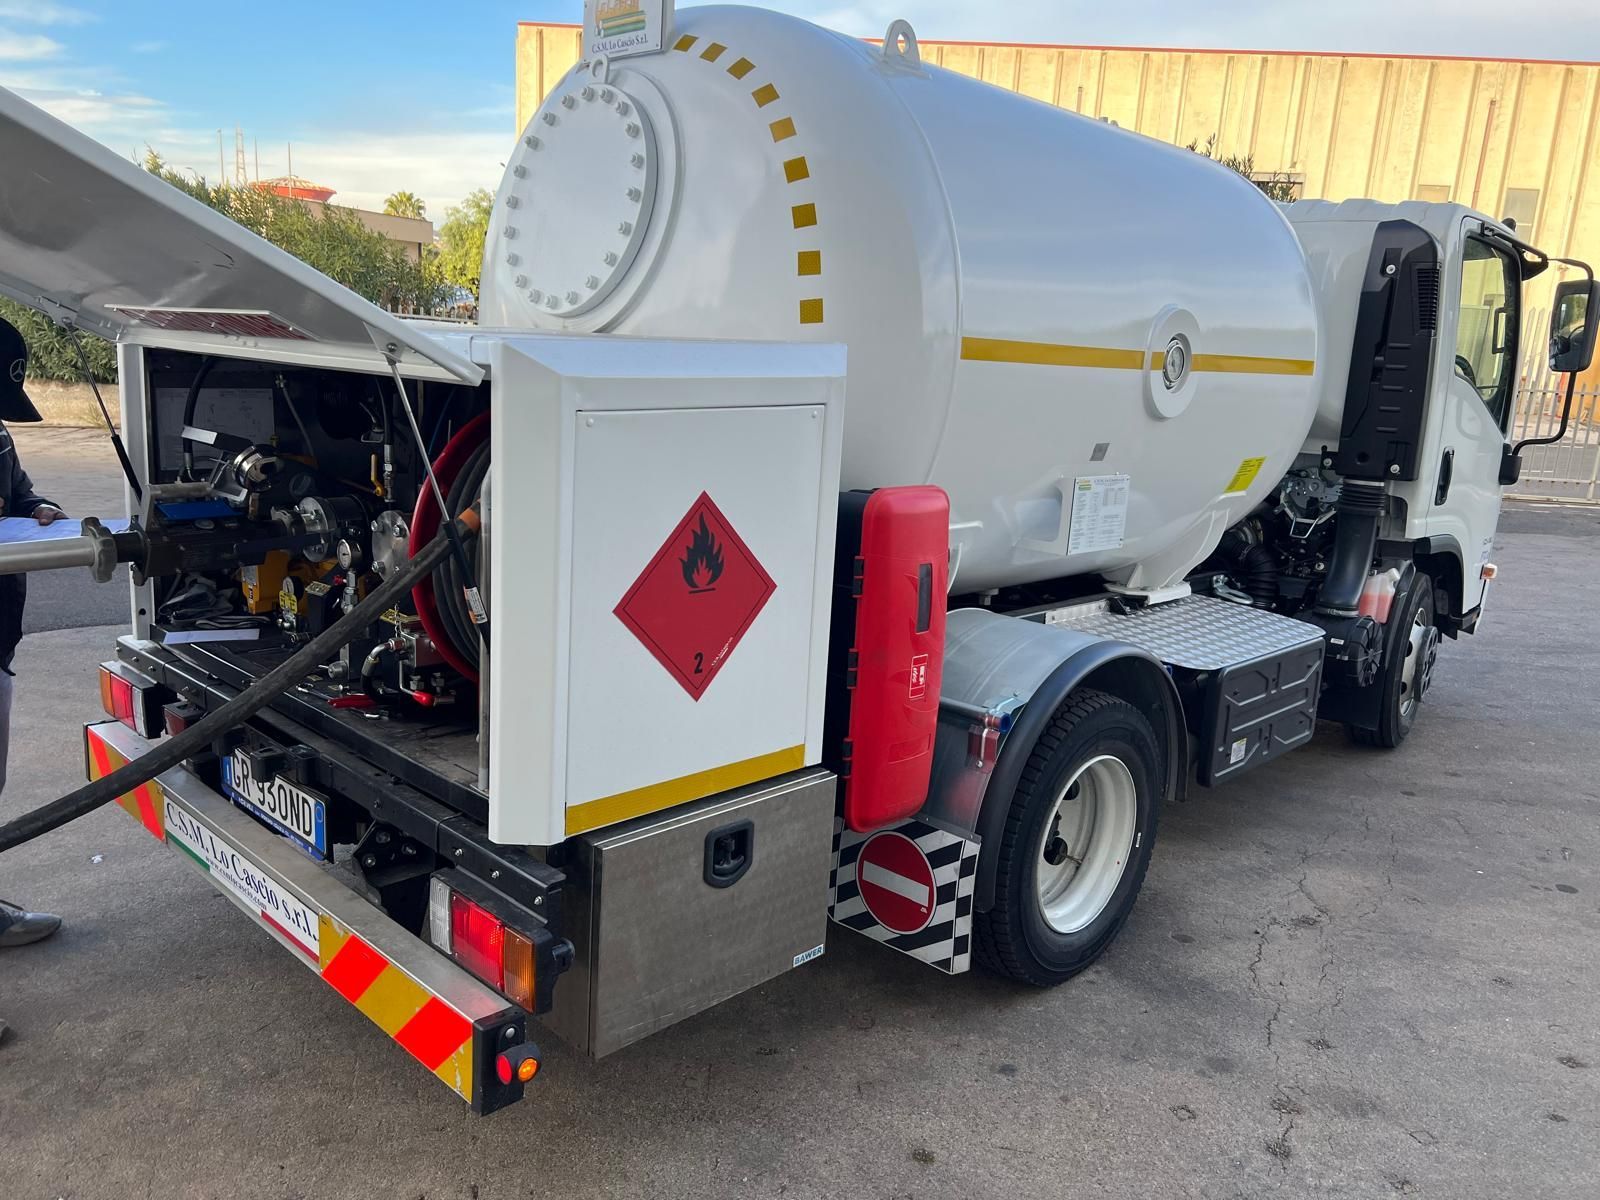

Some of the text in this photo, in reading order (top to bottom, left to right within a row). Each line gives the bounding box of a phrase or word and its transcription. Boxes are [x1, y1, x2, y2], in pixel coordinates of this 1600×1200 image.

[609, 41, 617, 50] Lo
[617, 37, 636, 49] Cascio
[694, 652, 704, 674] 2
[232, 753, 251, 797] GR
[166, 802, 209, 853] C.S.M.
[209, 834, 230, 869] Lo
[231, 854, 279, 911] Cascio
[794, 946, 823, 965] BAWER
